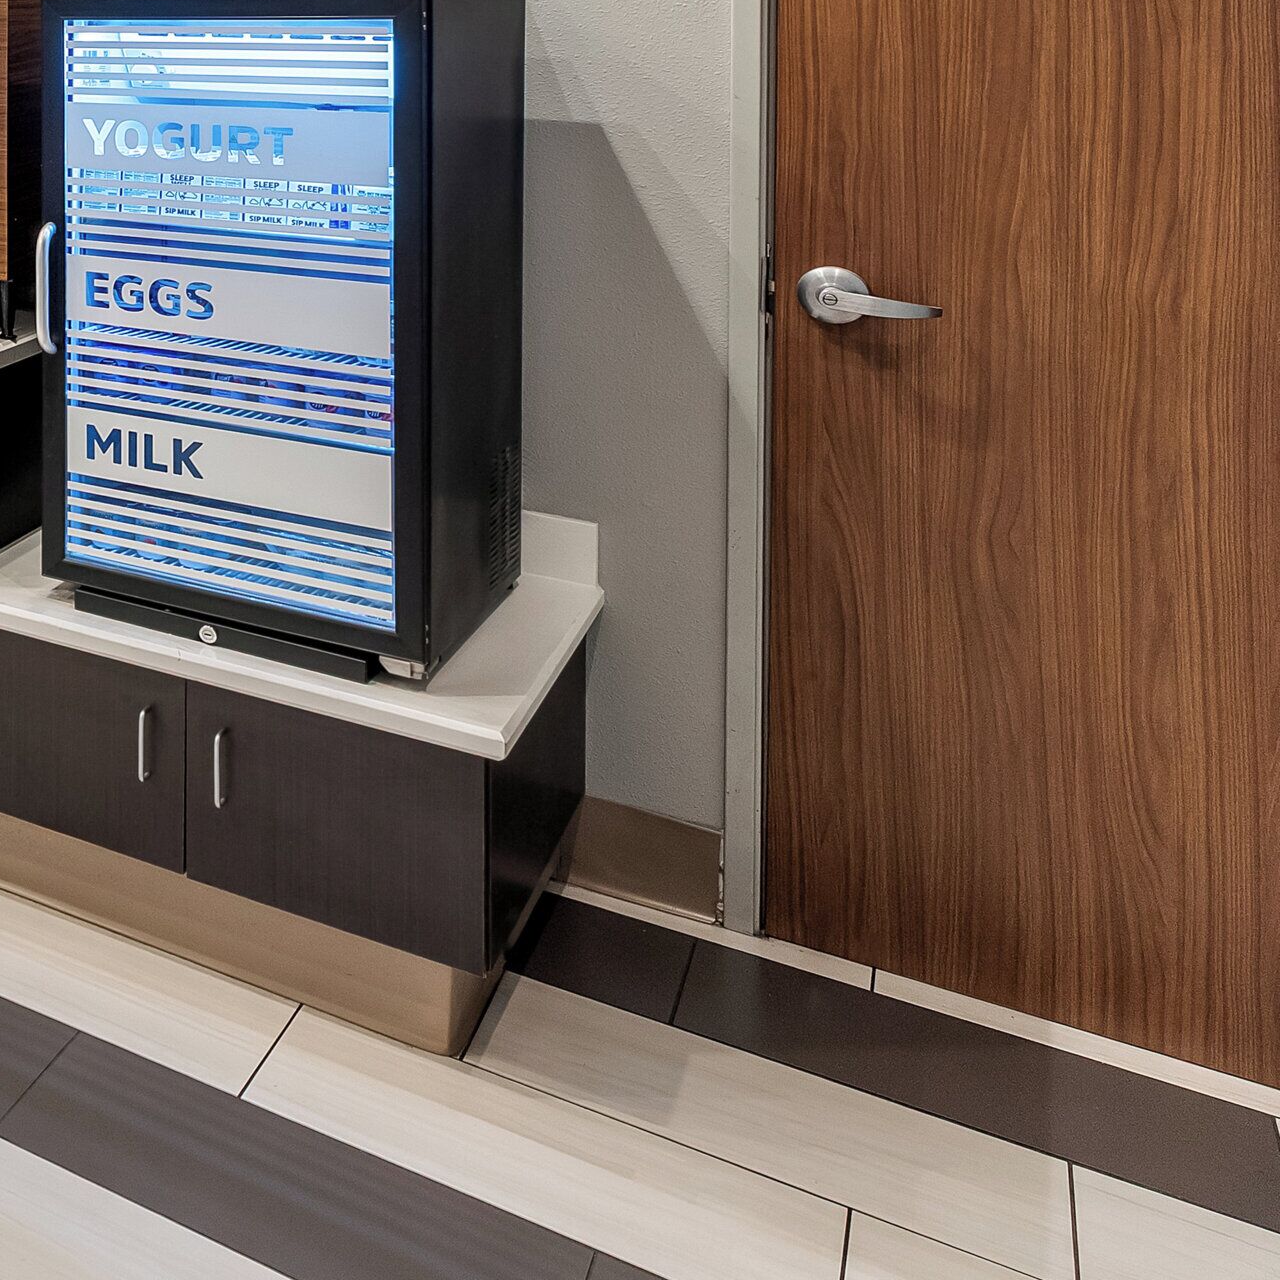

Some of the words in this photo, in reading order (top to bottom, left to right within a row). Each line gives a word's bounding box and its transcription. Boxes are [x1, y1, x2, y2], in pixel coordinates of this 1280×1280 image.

[82, 118, 294, 166] YOGURT
[170, 173, 195, 182] SLEEP
[253, 180, 280, 189] SLEEP
[297, 184, 324, 194] SLEEP
[164, 207, 176, 215] SIP
[177, 208, 196, 217] MILK
[249, 215, 261, 223] SIP
[262, 216, 283, 224] MILK
[85, 271, 214, 320] EGGS
[86, 424, 204, 480] MILK
